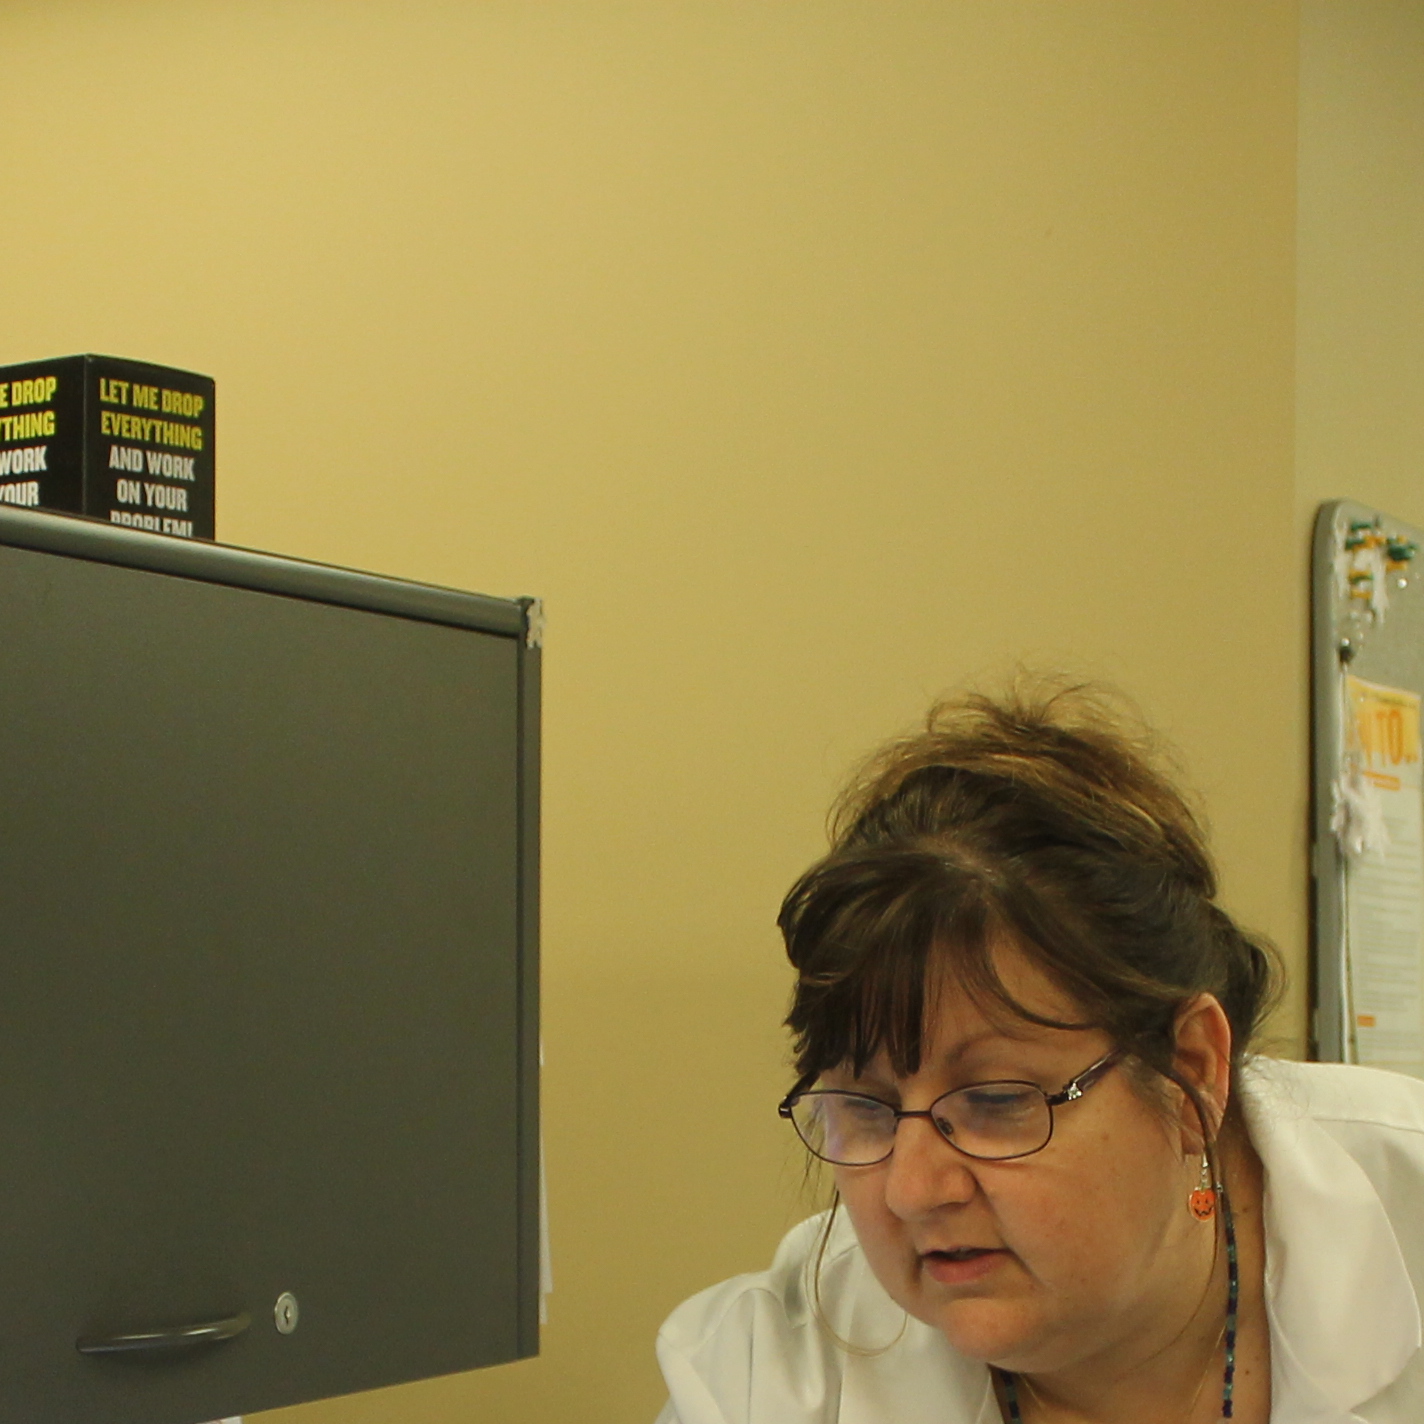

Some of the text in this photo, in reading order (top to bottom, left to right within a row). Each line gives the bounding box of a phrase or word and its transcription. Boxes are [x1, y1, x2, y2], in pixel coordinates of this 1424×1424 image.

[11, 376, 57, 406] DROP
[99, 377, 204, 418] LET ME DROP
[101, 410, 203, 451] EVERYTHING
[108, 444, 195, 482] AND WORK
[116, 478, 188, 512] ON YOUR
